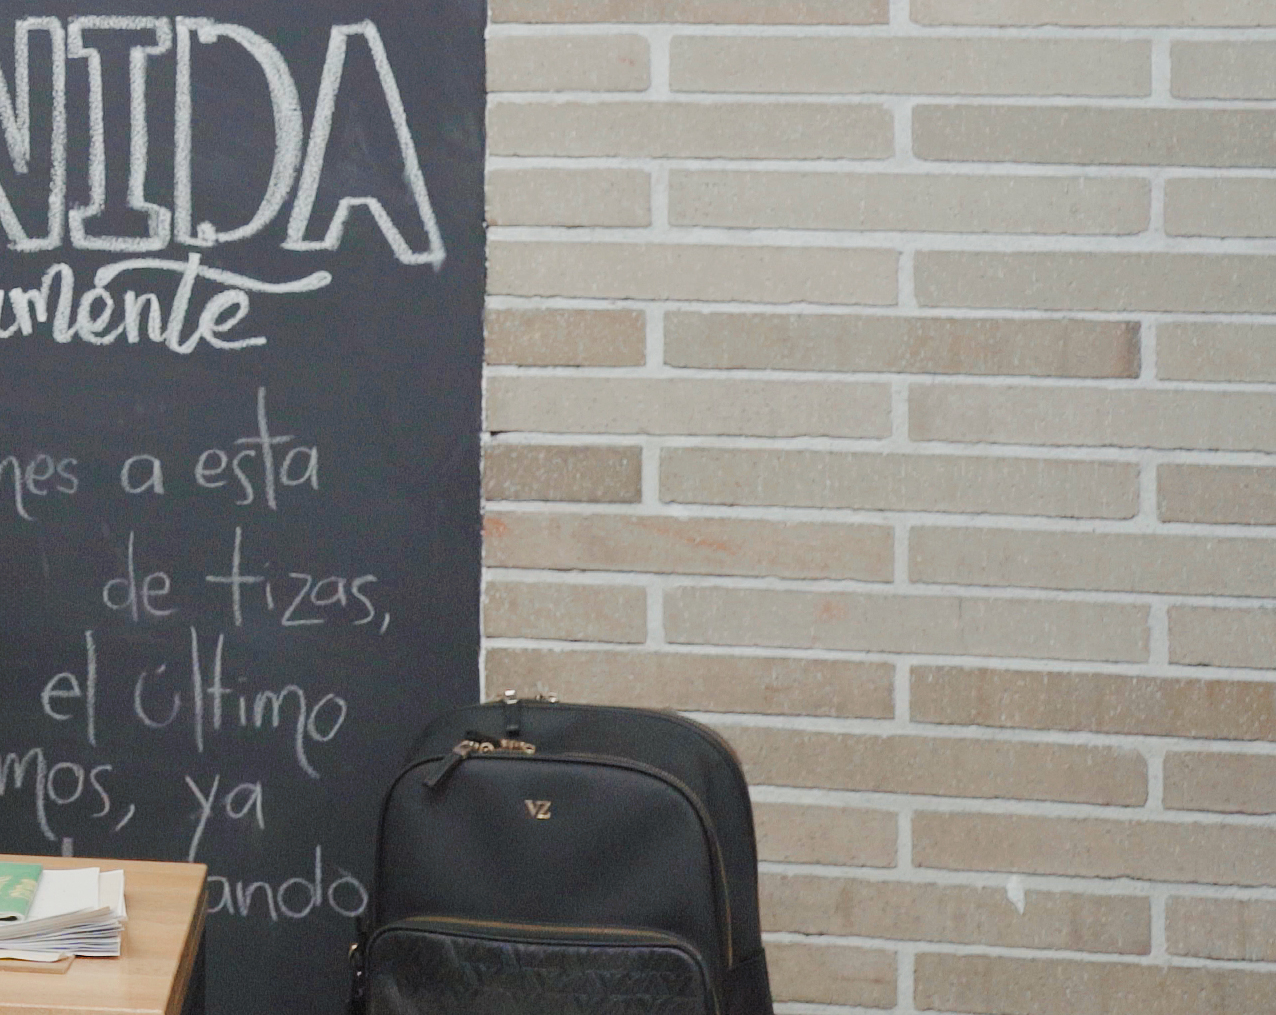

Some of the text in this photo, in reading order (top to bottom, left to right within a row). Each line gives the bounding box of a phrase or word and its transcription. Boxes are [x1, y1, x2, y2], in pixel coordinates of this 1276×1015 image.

[121, 454, 164, 494] a
[195, 387, 318, 509] esta
[103, 527, 390, 632] de tizas,
[41, 630, 97, 745] el
[134, 625, 347, 779] último
[184, 775, 265, 863] ya
